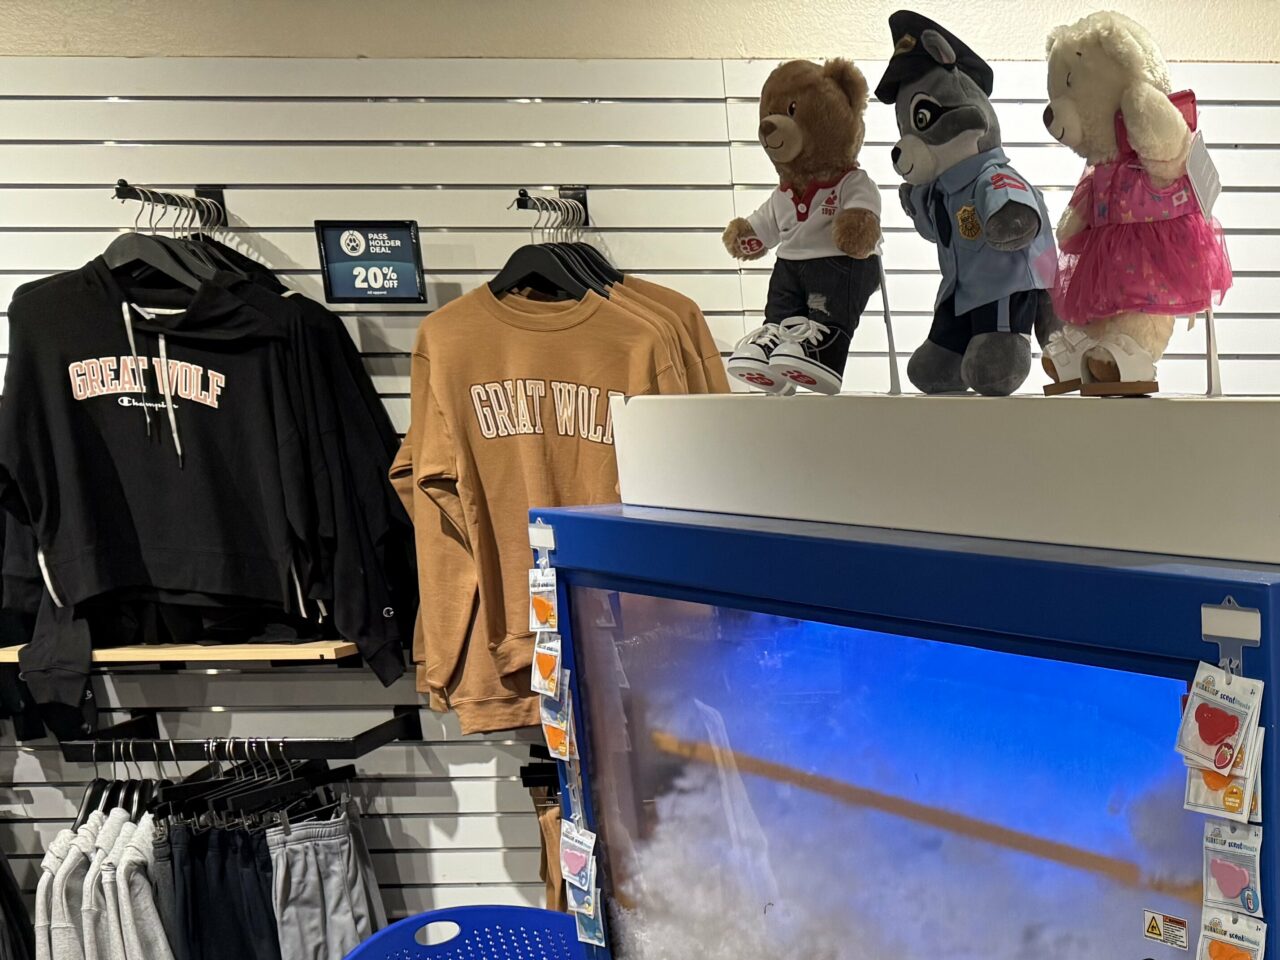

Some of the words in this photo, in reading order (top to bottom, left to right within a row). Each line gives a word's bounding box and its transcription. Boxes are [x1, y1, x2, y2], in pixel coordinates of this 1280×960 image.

[352, 266, 397, 289] 20%
[383, 280, 398, 288] OFF
[68, 356, 149, 401] GREAT
[152, 358, 226, 409] WOLF
[117, 396, 179, 411] Champin
